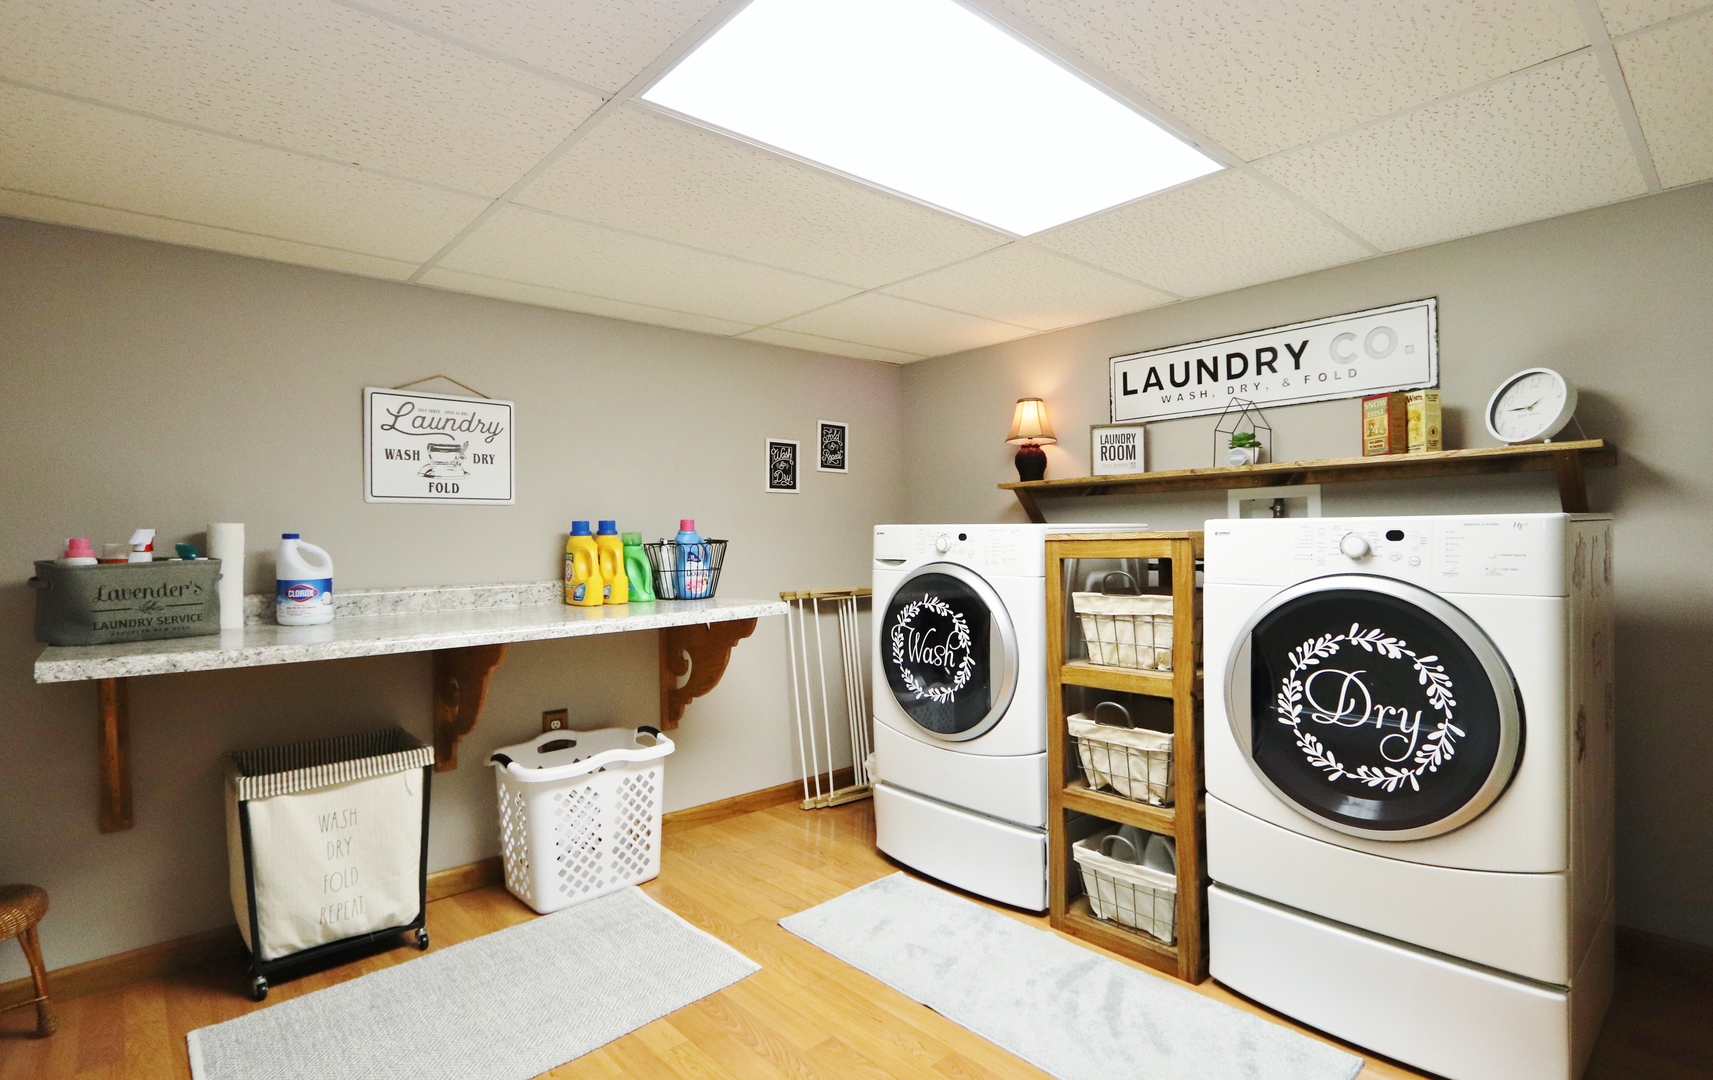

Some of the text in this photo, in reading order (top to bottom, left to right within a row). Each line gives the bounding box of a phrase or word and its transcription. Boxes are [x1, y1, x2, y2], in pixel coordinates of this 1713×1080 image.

[1122, 325, 1415, 396] LAUNDRY CO.
[1161, 368, 1358, 404] WASH, DRY, & FOLD
[1364, 399, 1387, 410] SNOW
[1367, 408, 1384, 418] DUST
[380, 401, 504, 443] Laundry
[1100, 433, 1136, 445] LAUNDRY
[384, 448, 420, 461] WASH
[472, 453, 496, 465] DRY
[1101, 444, 1136, 461] ROOM
[428, 481, 460, 494] FOLD
[92, 580, 203, 603] Lavender's
[287, 589, 315, 598] CLOROX
[93, 613, 203, 631] LAUNDRY SERVICE
[891, 623, 963, 668] Wash
[1304, 668, 1423, 763] Dry
